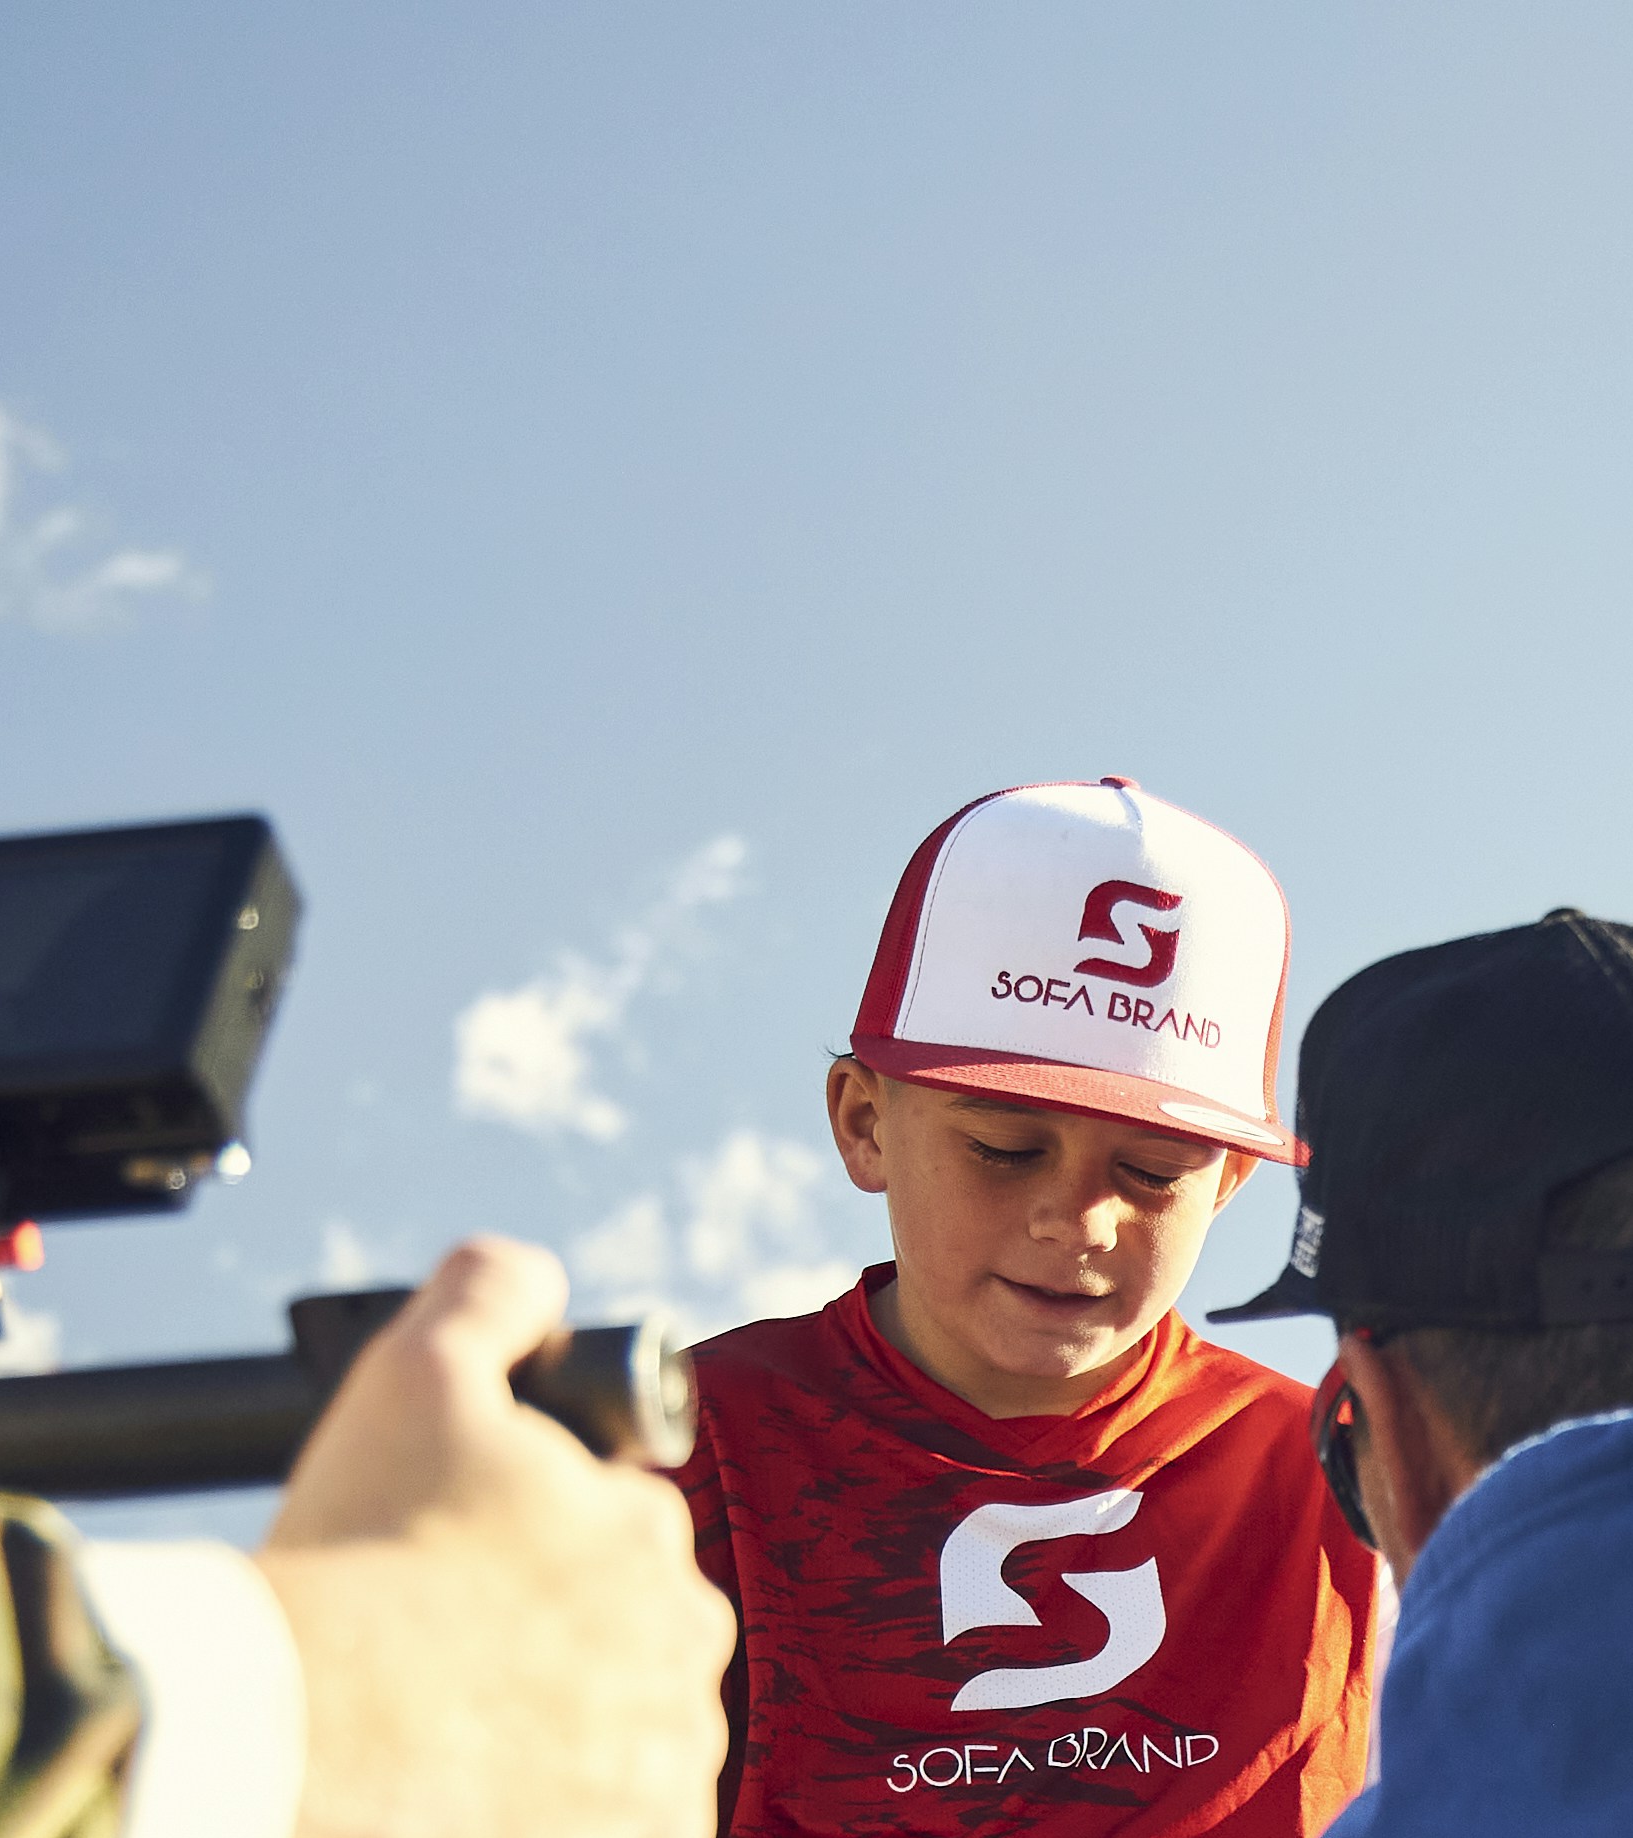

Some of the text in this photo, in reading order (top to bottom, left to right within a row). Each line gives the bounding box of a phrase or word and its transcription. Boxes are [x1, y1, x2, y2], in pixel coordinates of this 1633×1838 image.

[991, 971, 1221, 1049] SOFA BRAND
[886, 1727, 1220, 1793] SOFA BRAND
